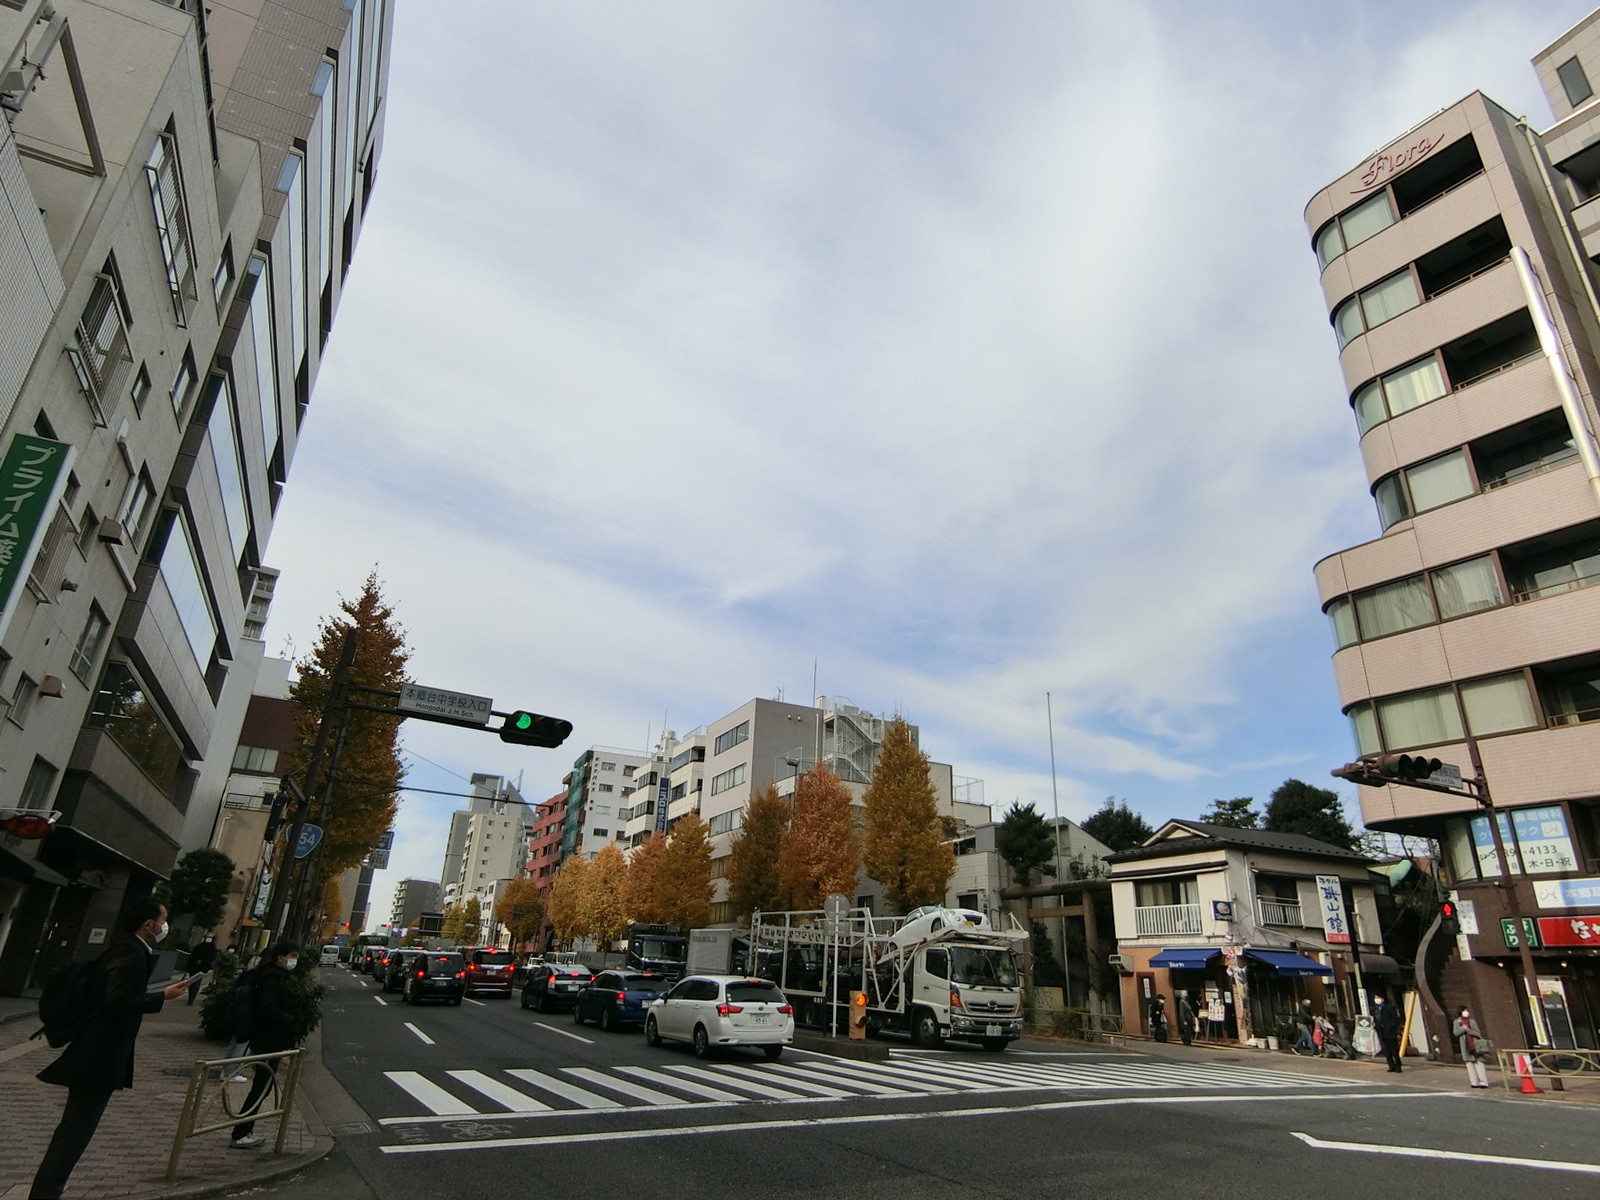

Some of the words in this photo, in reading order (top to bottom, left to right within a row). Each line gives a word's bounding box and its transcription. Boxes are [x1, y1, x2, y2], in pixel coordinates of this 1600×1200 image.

[1361, 138, 1432, 187] Flora
[0, 445, 57, 584] プライム
[406, 688, 488, 712] 本郷台中学校入口
[415, 702, 446, 713] Hongodai
[299, 832, 316, 847] 54
[1479, 826, 1538, 841] クニック
